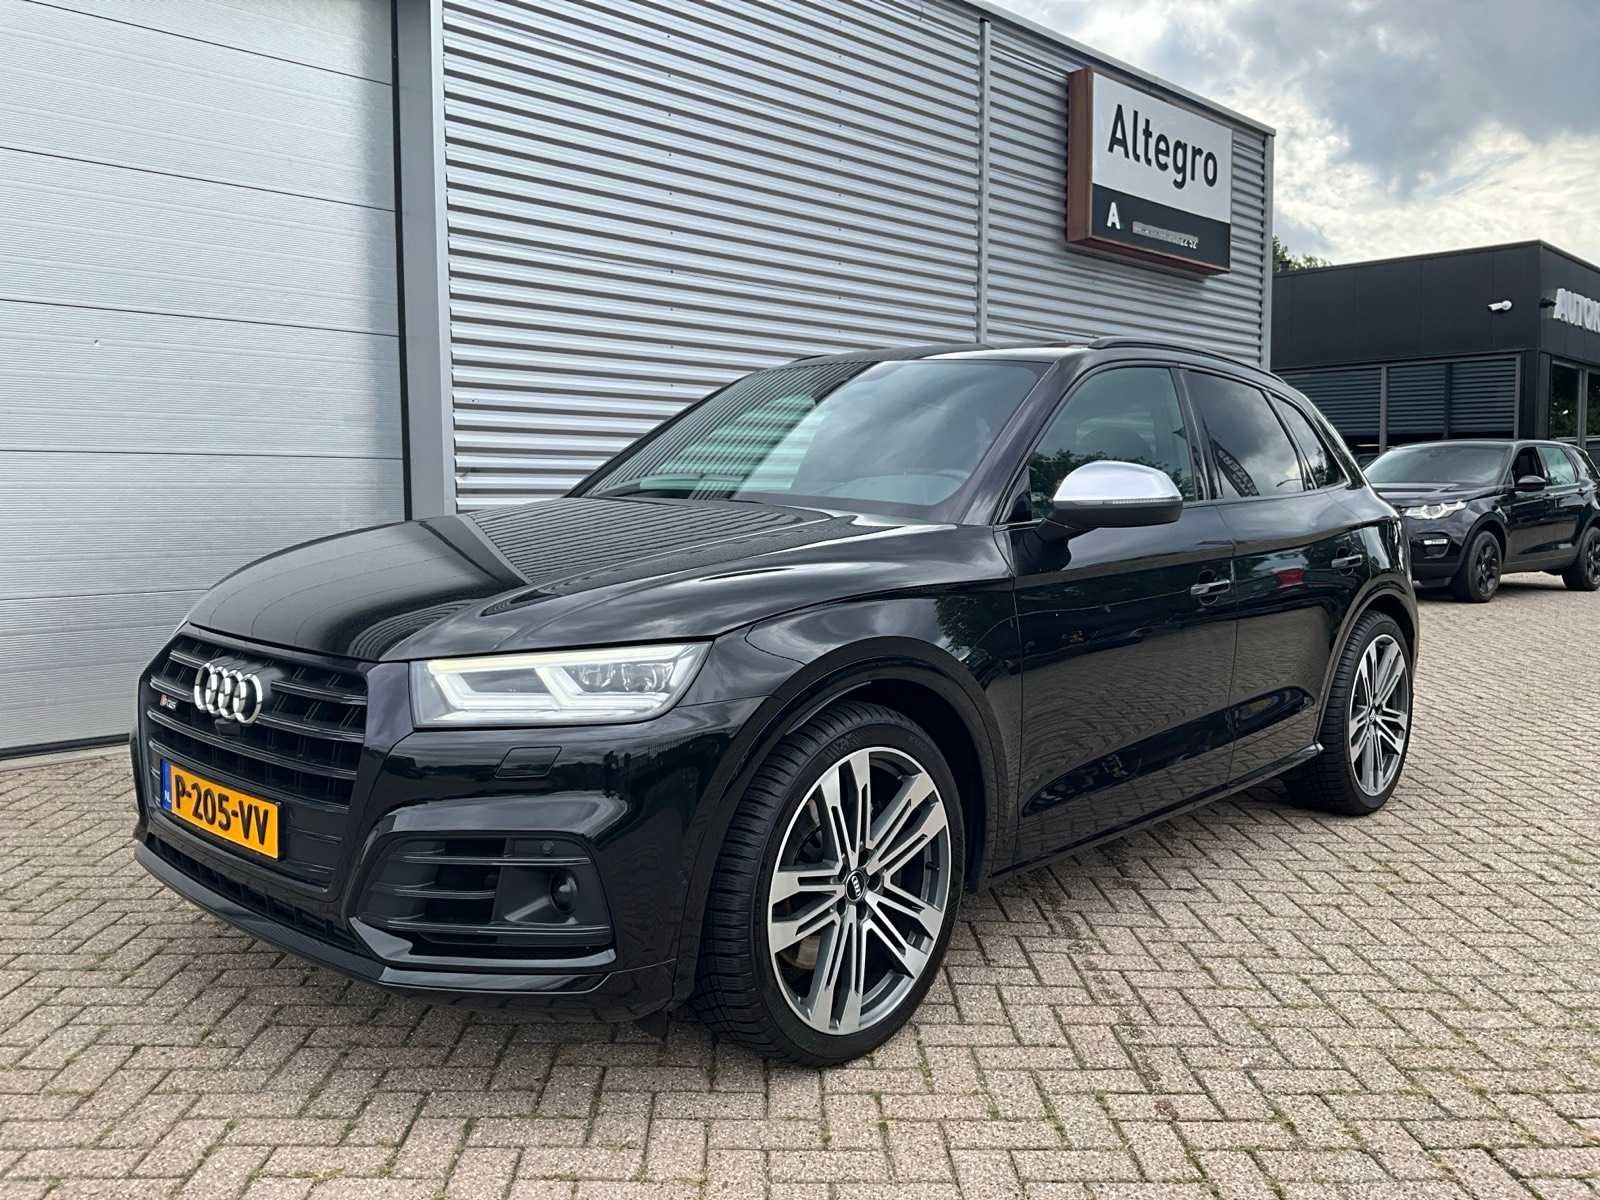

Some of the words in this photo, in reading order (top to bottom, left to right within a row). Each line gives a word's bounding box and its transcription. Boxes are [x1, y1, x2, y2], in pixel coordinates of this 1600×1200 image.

[1107, 103, 1218, 190] Altegro
[1106, 202, 1121, 230] A
[175, 774, 269, 846] P-205-VV
